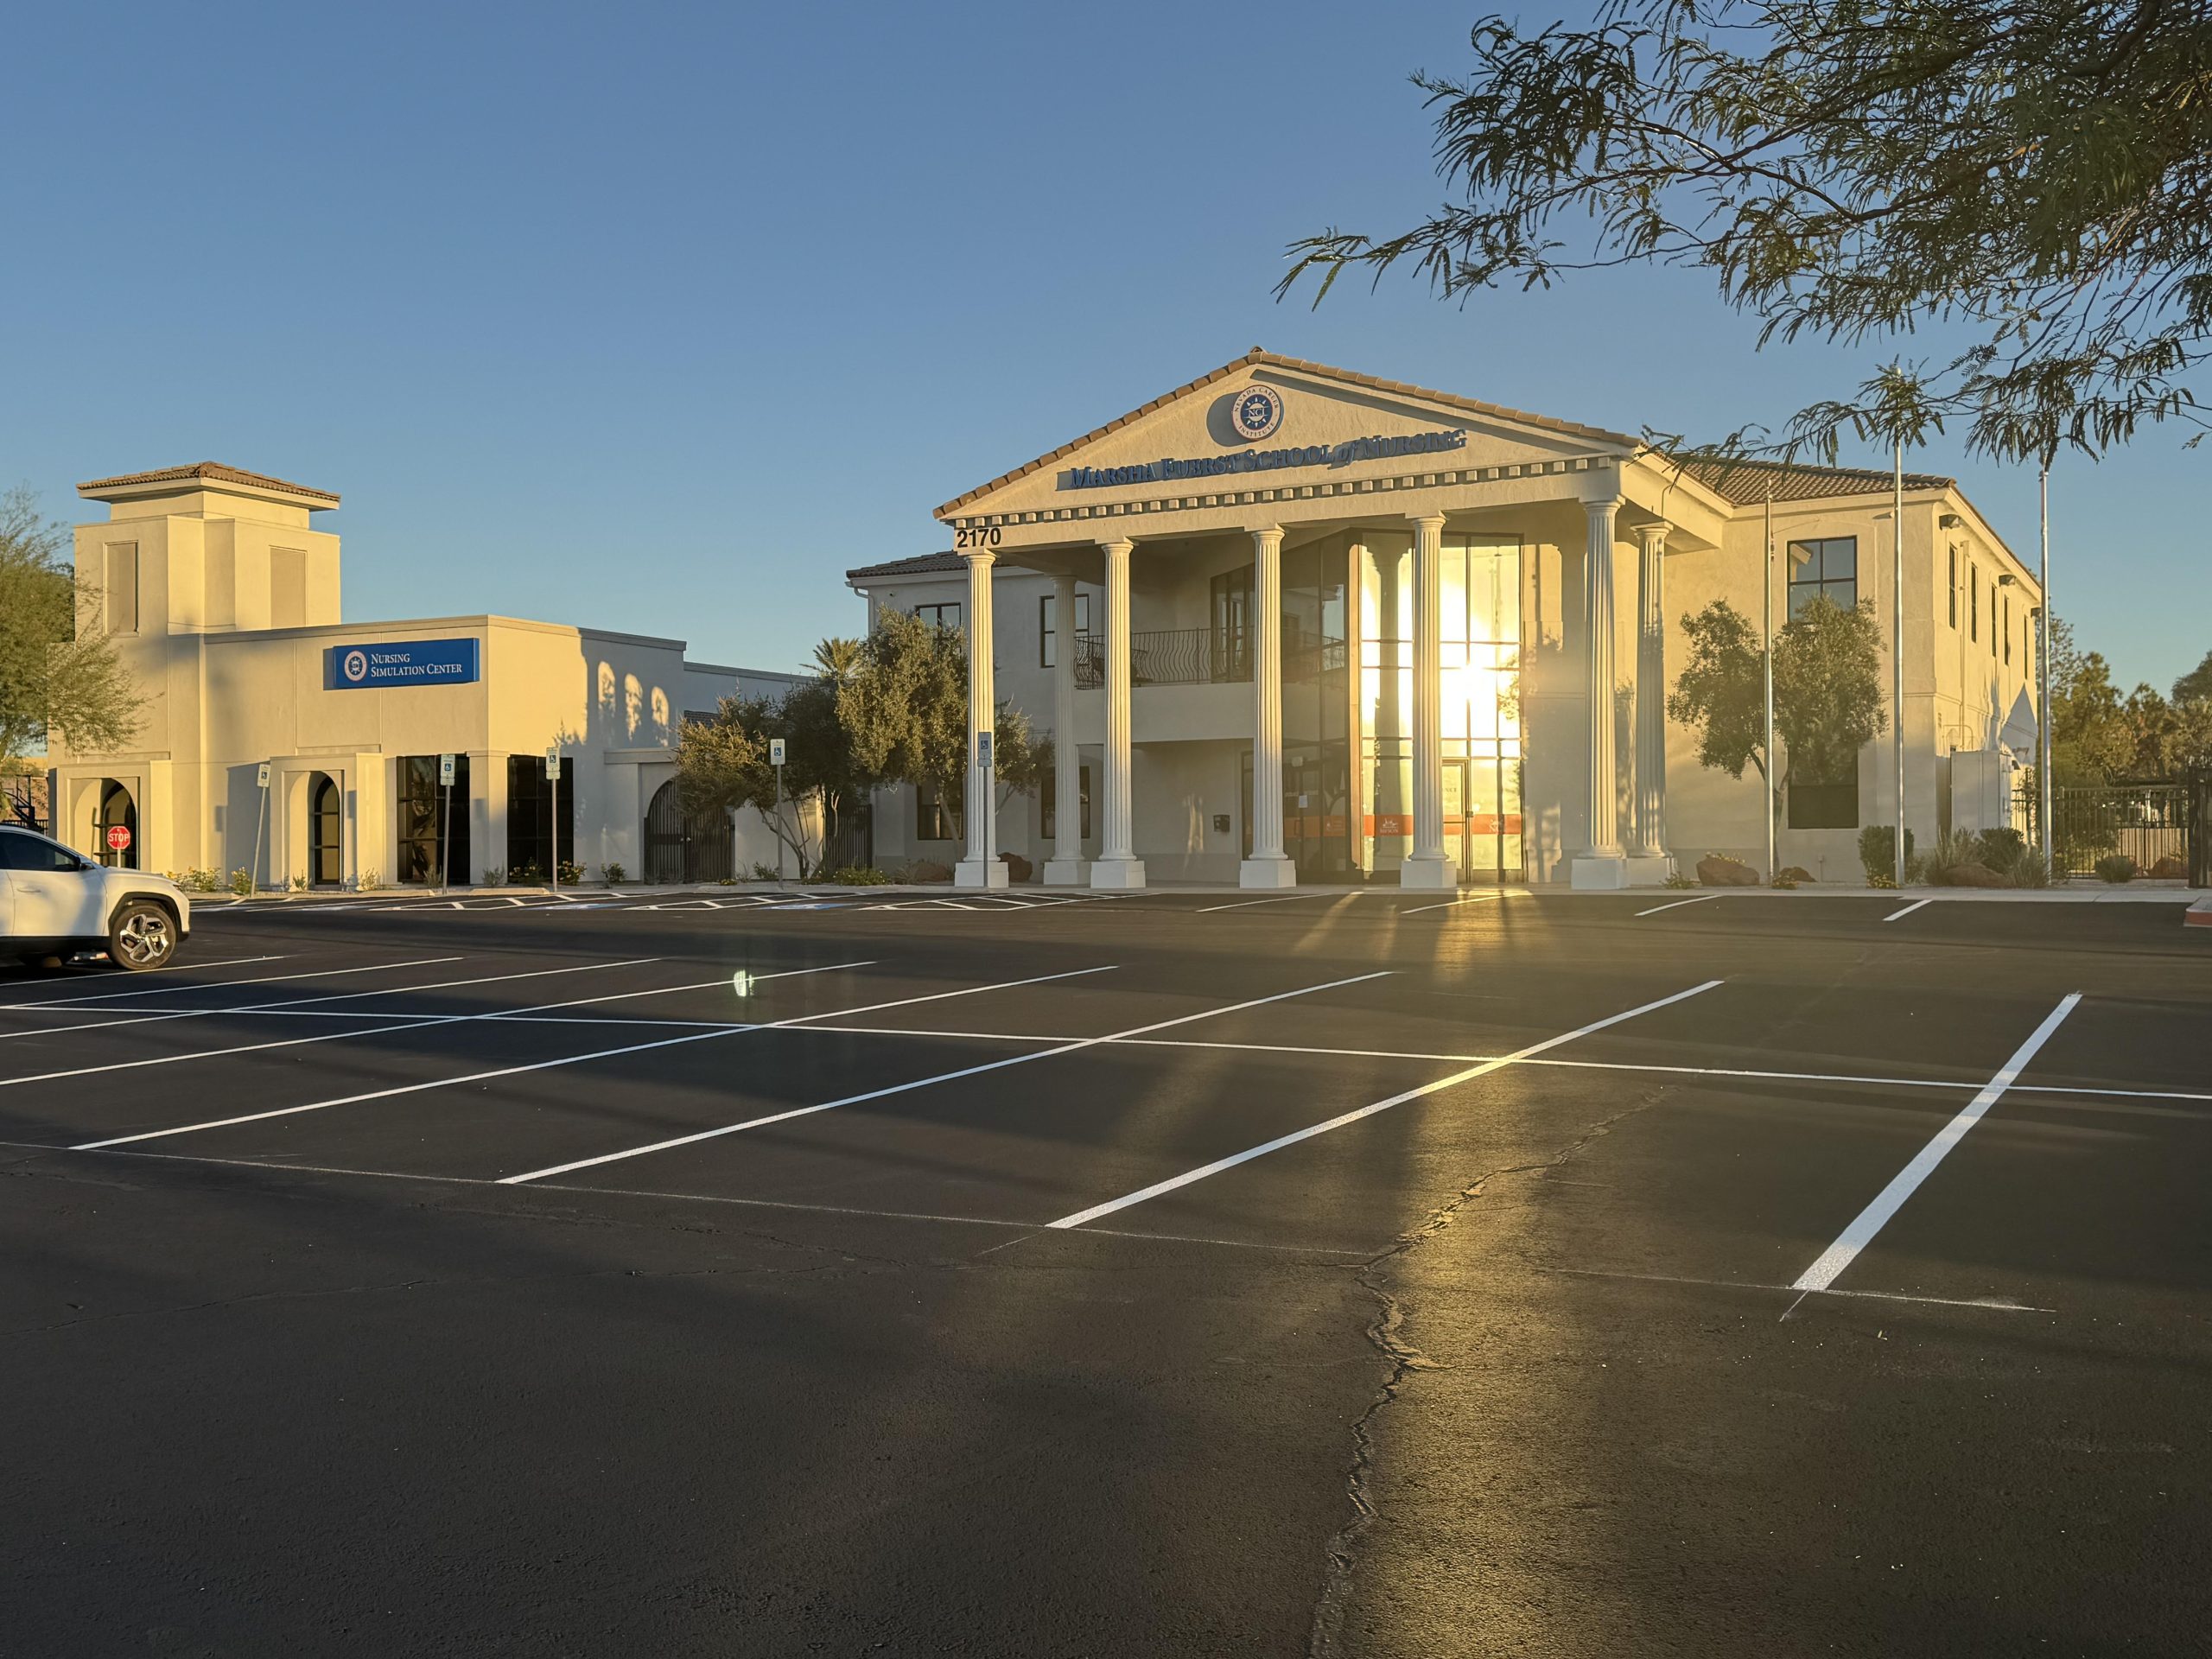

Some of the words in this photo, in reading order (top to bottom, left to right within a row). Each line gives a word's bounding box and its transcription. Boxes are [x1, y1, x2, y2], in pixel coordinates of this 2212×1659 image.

[1234, 388, 1255, 412] NEVADA
[1259, 387, 1280, 409] CAREER
[1248, 407, 1265, 417] NCI
[1238, 422, 1274, 437] INSTITUTE
[1070, 462, 1157, 490] MARSHA
[1160, 454, 1241, 481] FUERST
[1244, 445, 1333, 472] SCHOOL
[1336, 440, 1359, 466] of
[1360, 429, 1467, 459] NURSING
[957, 527, 1001, 548] 2170
[371, 653, 410, 664] NURSING
[371, 665, 425, 677] SIMULATION
[426, 664, 462, 674] CENTER
[109, 833, 130, 842] STOP
